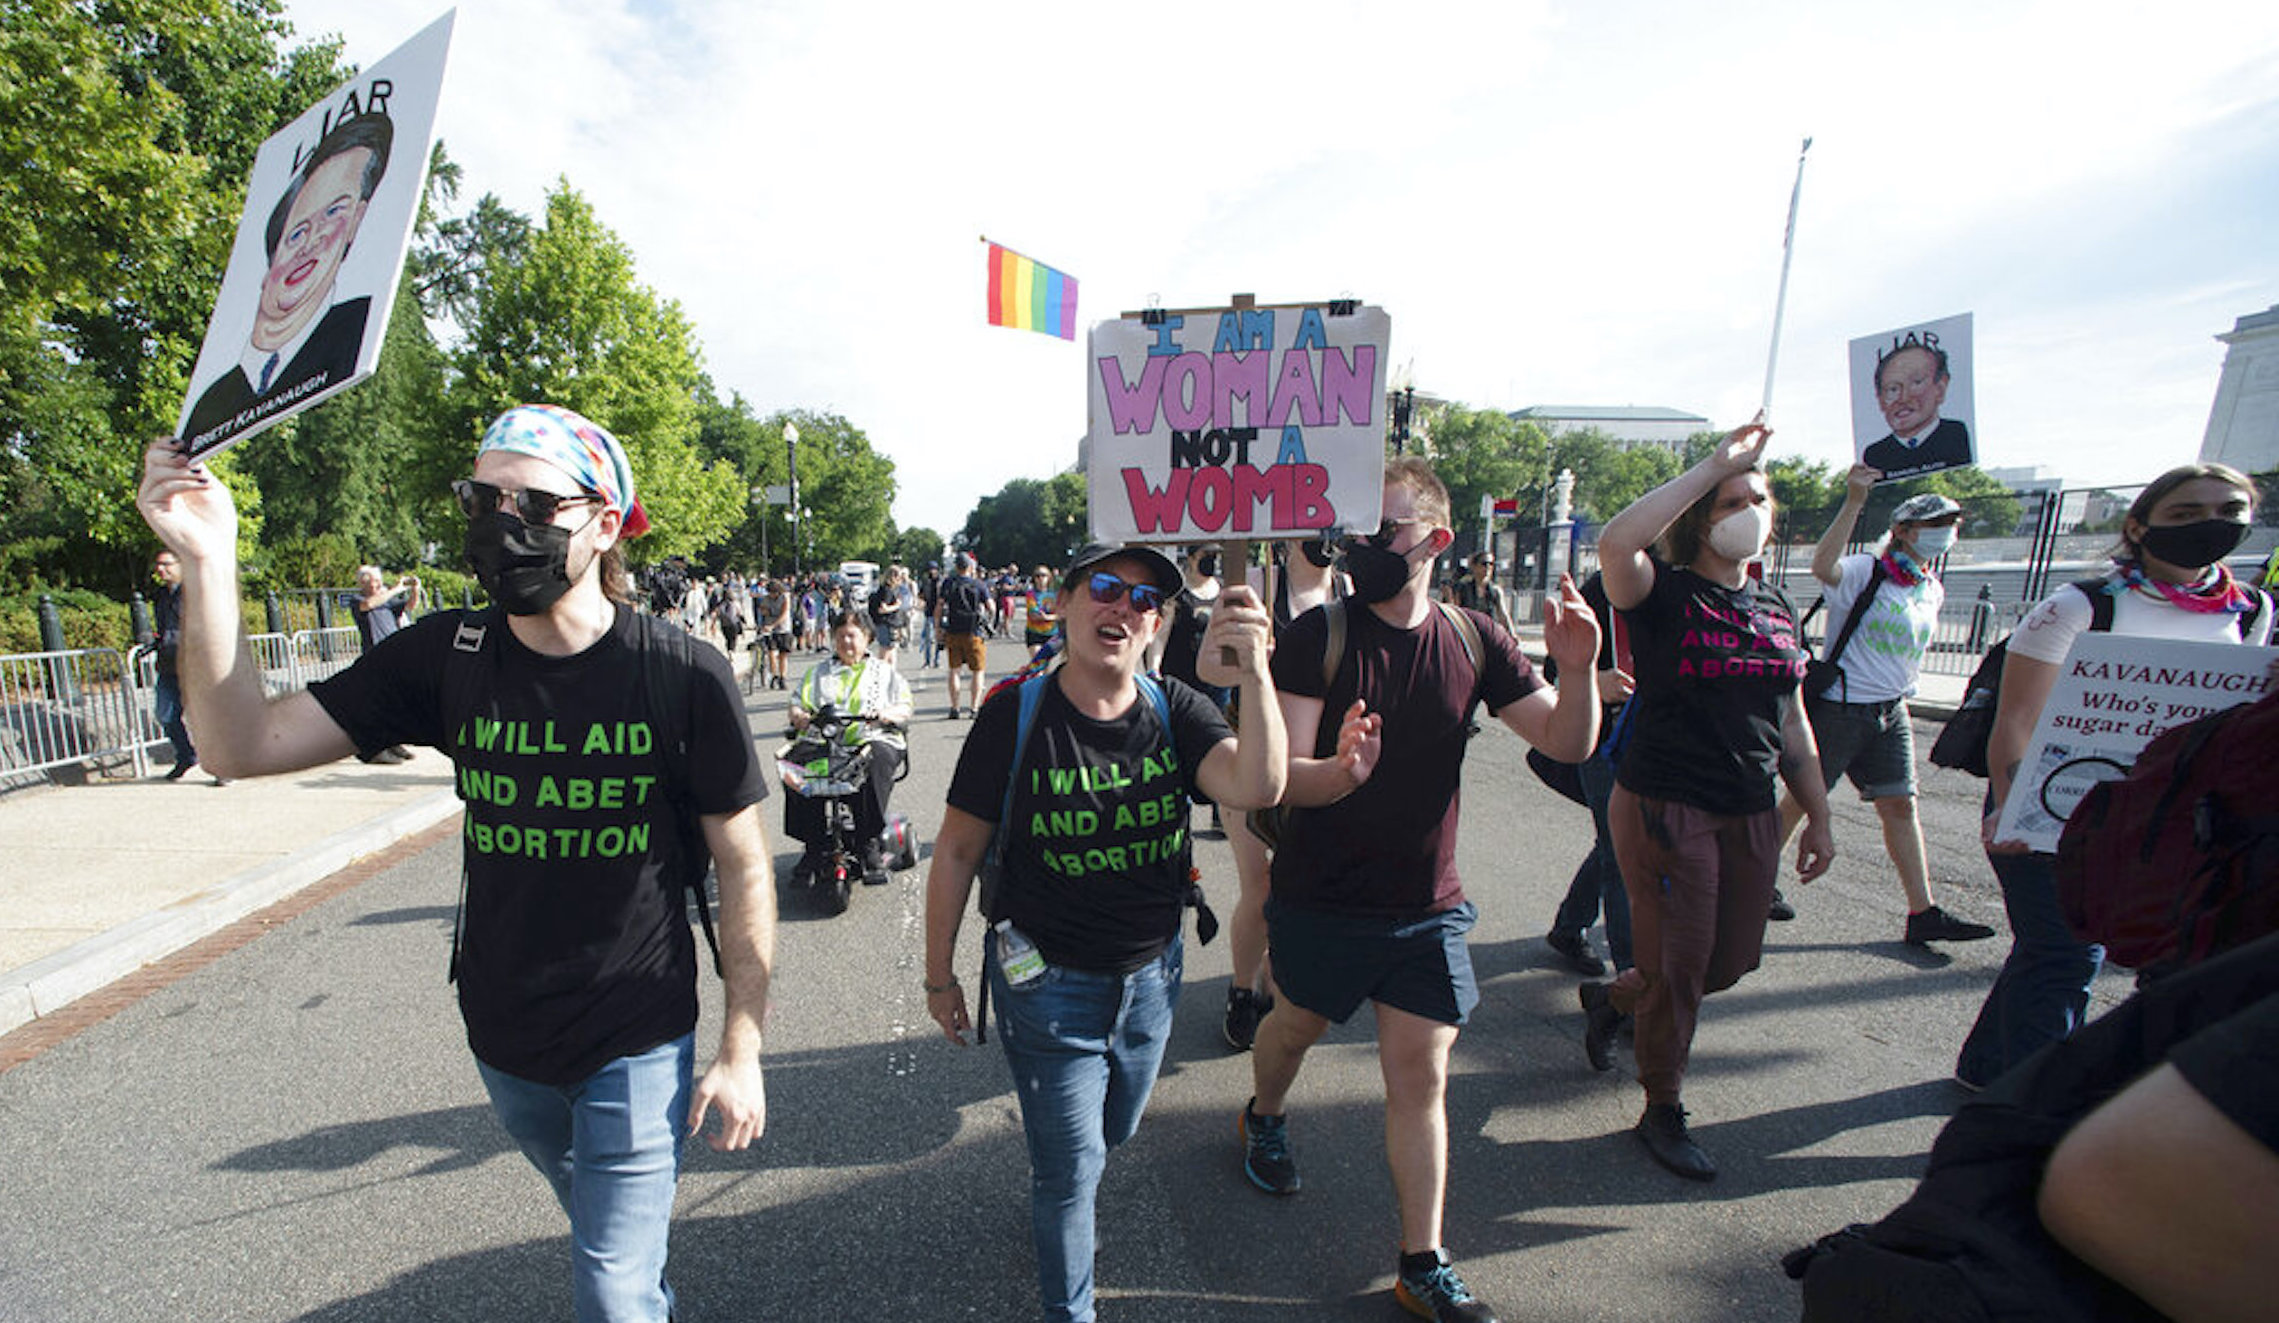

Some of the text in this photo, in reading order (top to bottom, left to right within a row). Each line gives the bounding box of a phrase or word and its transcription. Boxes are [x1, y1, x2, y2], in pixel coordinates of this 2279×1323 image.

[291, 79, 394, 177] LIAR
[1147, 308, 1328, 356] I AM A
[234, 370, 329, 429] KAVANAUGH
[1098, 344, 1376, 435] WOMAN
[1171, 425, 1307, 468] NOT A
[1120, 463, 1337, 534] WOMB
[1680, 628, 1740, 649] AND
[1678, 656, 1808, 679] ABORTIO
[2071, 660, 2271, 694] KAVANAUGH
[2052, 714, 2130, 736] sugar
[2082, 691, 2217, 720] Who's you
[475, 716, 567, 755] WILL
[581, 721, 654, 755] AID
[536, 774, 657, 810] ABET
[1032, 768, 1040, 795] I
[1048, 763, 1132, 796] WILL
[1031, 787, 1183, 837] AND ABE
